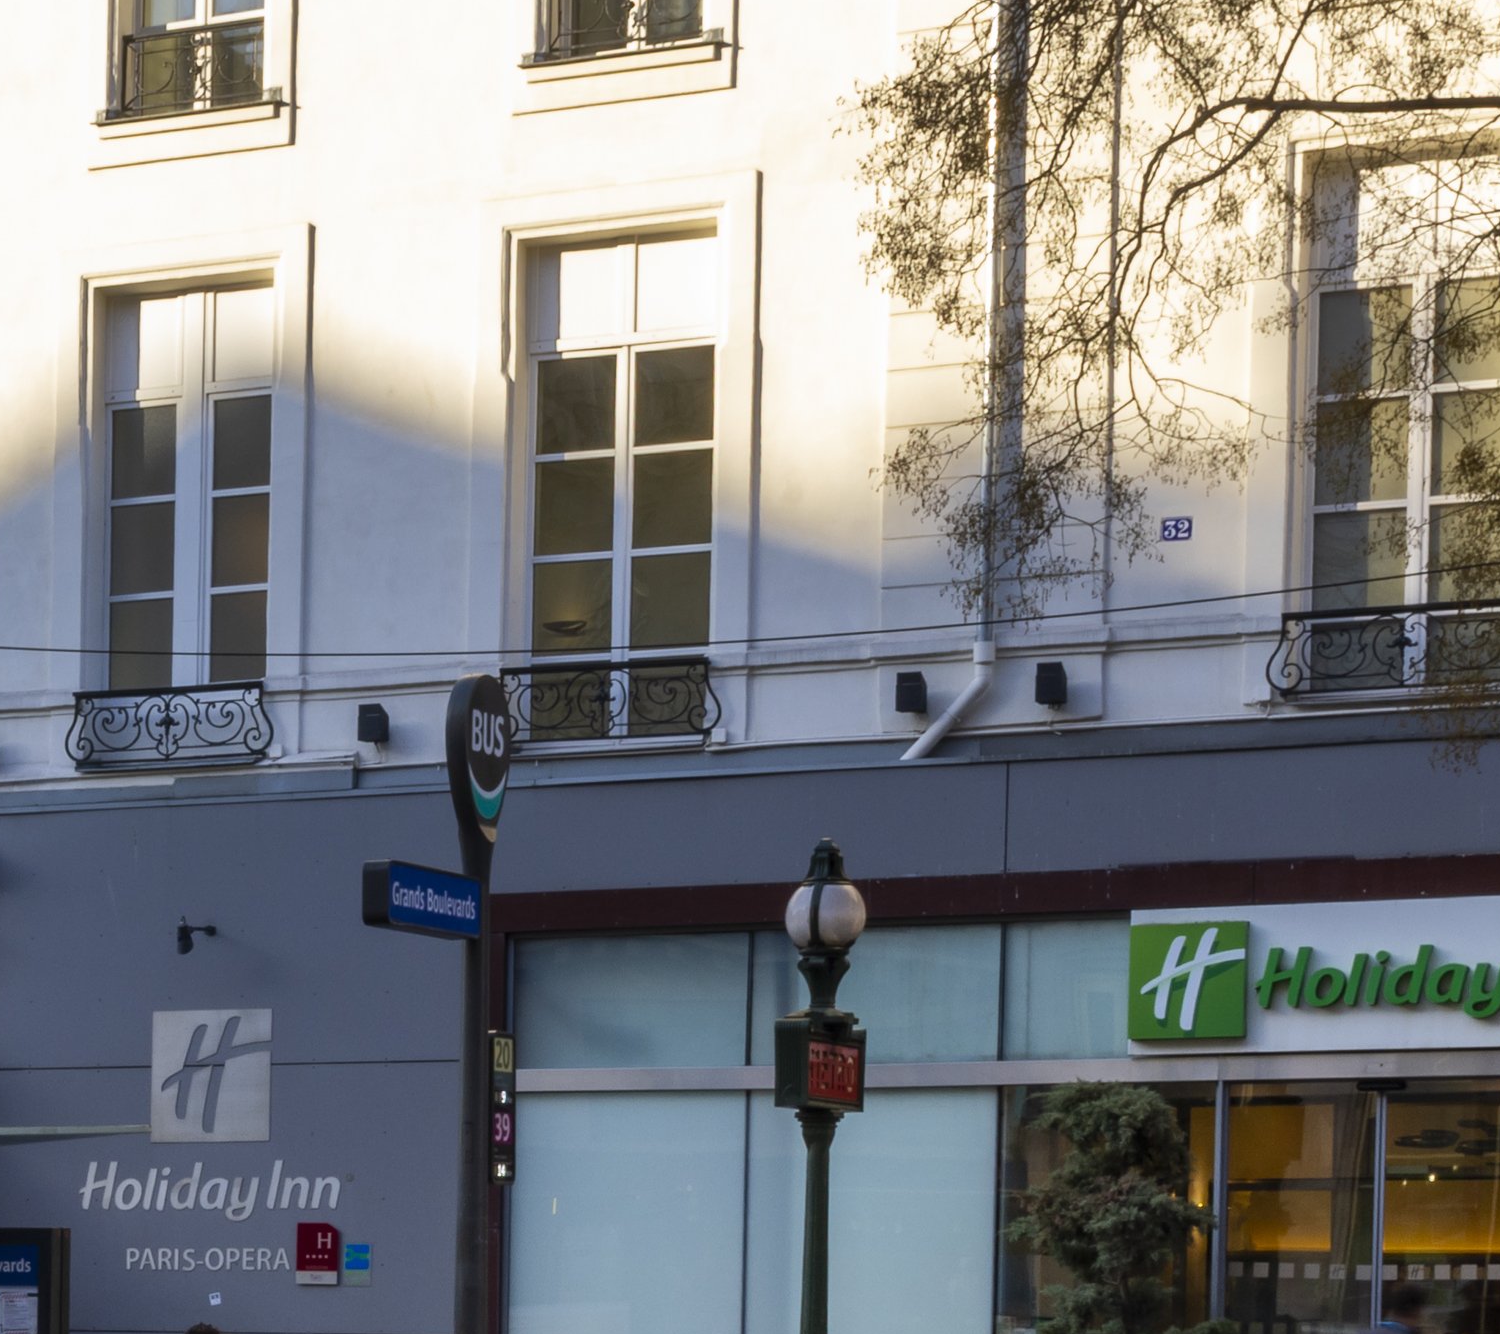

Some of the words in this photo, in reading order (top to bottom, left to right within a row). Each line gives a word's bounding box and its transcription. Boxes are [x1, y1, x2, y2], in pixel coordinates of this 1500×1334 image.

[1164, 519, 1190, 539] 32
[472, 709, 505, 757] BUS
[392, 881, 424, 910] Grands
[427, 888, 476, 920] Boulevards
[494, 1112, 510, 1142] 39
[79, 1161, 259, 1221] Holiday
[267, 1160, 341, 1209] Inn
[317, 1232, 332, 1249] H
[126, 1247, 290, 1271] PARIS-OPERA
